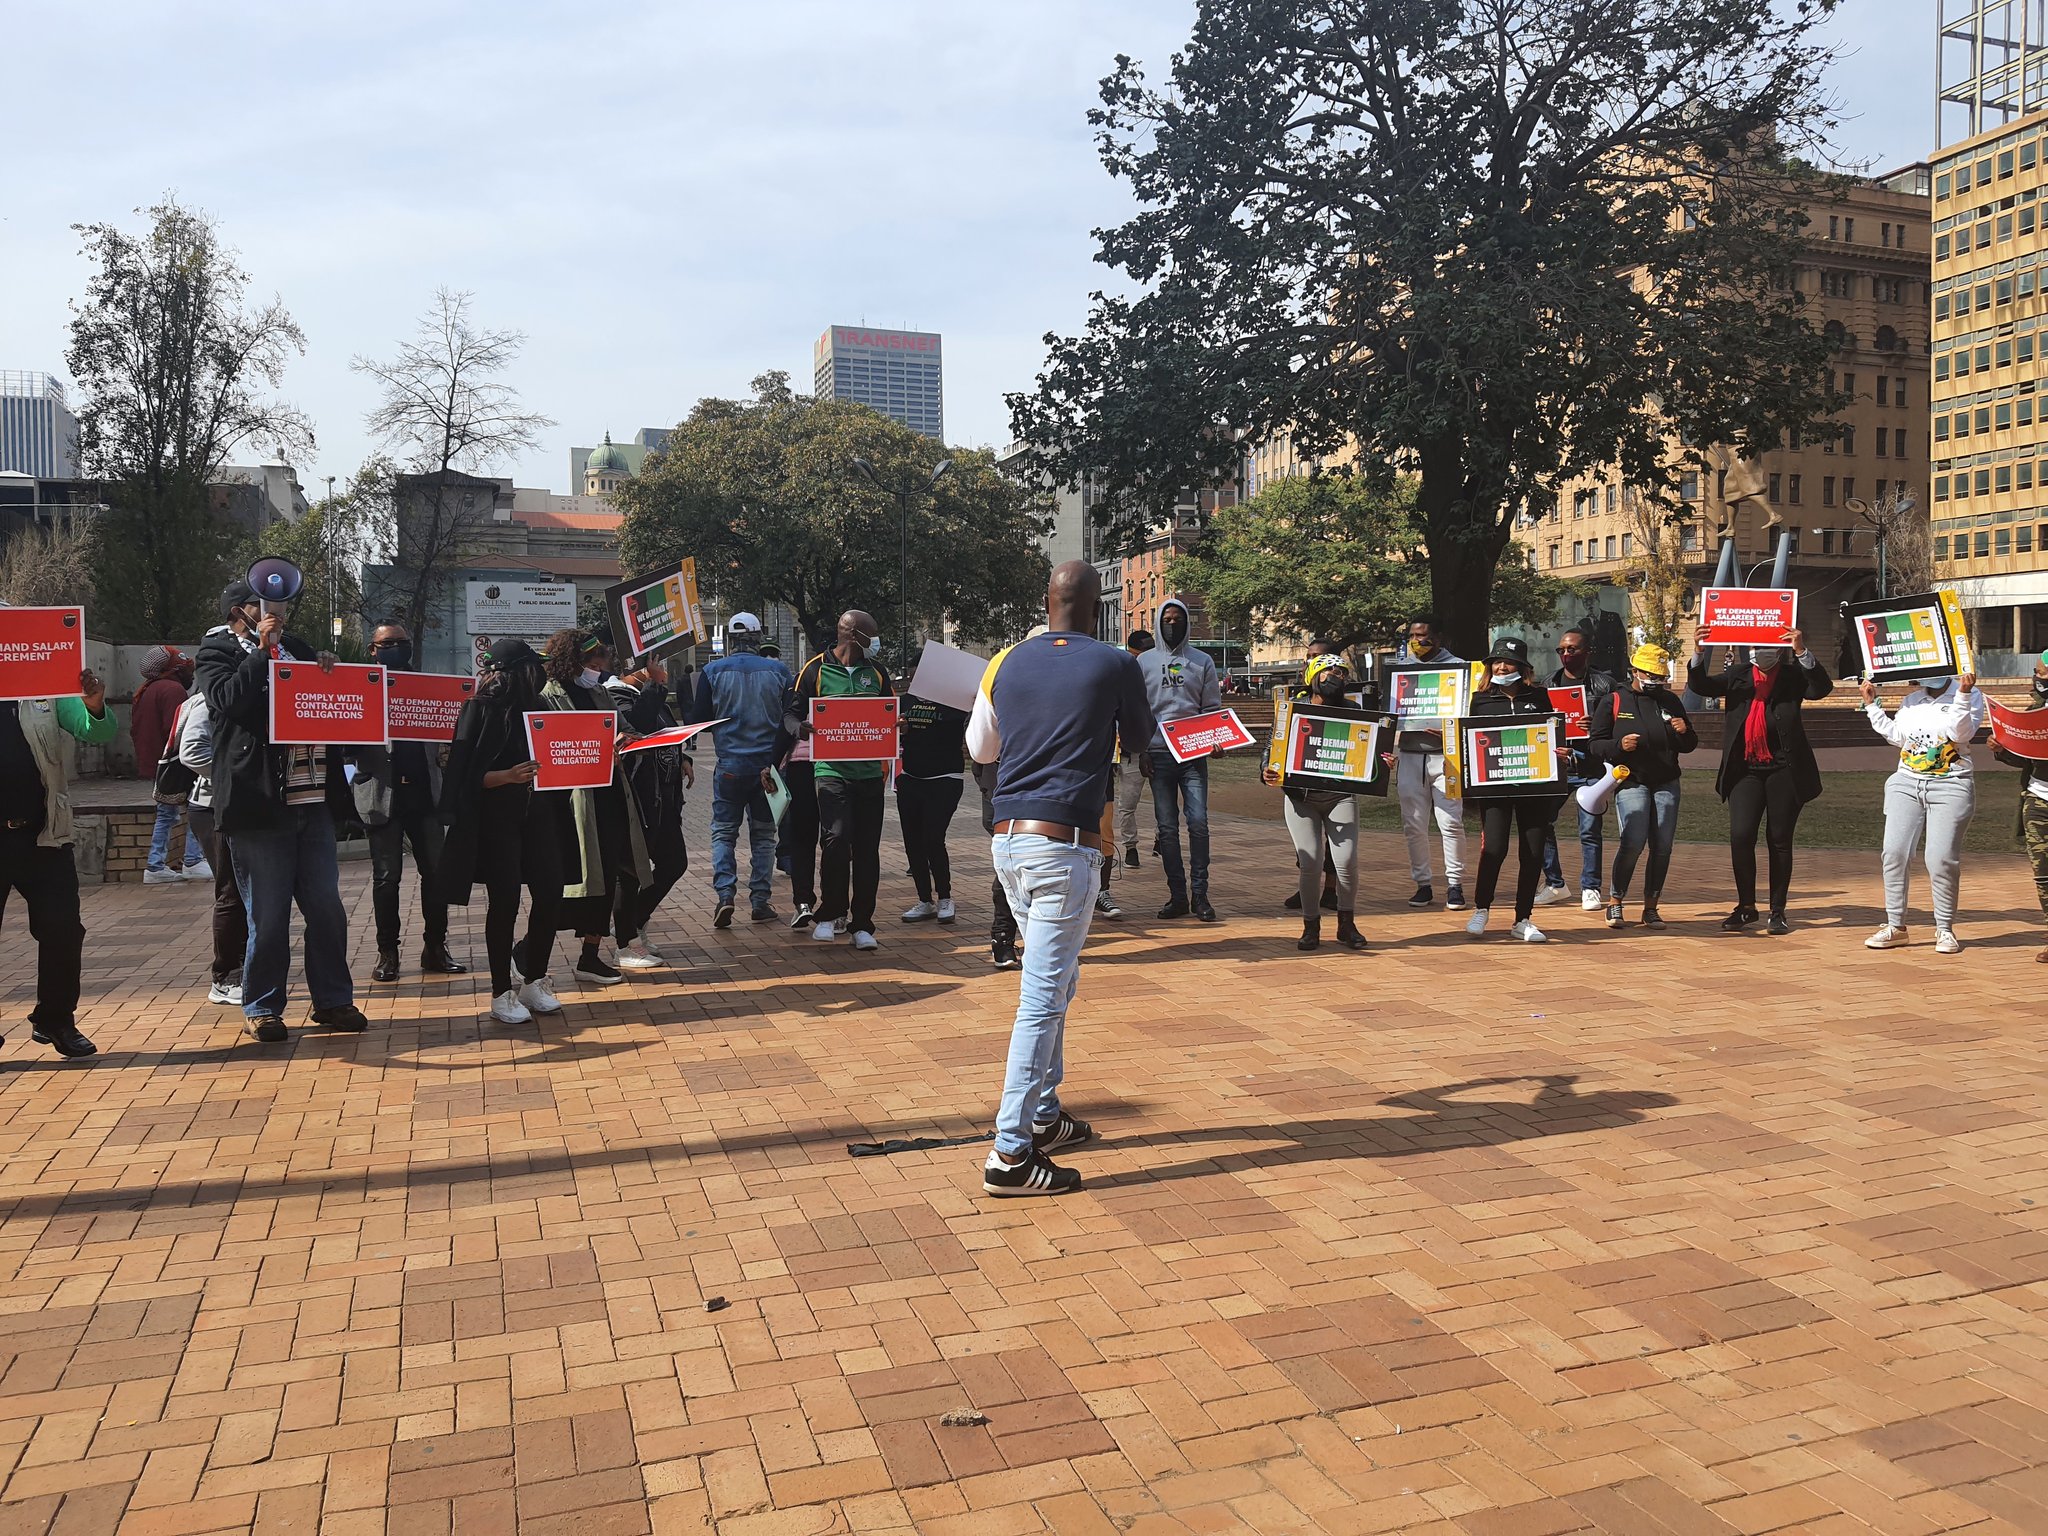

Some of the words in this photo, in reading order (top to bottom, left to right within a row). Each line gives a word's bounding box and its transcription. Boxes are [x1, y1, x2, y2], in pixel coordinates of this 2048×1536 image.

[836, 329, 936, 352] TRANSNET
[636, 614, 646, 622] WE
[646, 604, 666, 619] DEMAND
[642, 617, 661, 631] SALARY
[1886, 632, 1900, 641] PAY
[1901, 630, 1913, 640] UIF
[33, 642, 74, 651] SALARY
[1872, 640, 1933, 654] CONTRIBUTIONS
[1873, 657, 1884, 666] OR
[1884, 655, 1902, 665] FACE
[1903, 653, 1918, 663] JAIL
[1919, 651, 1938, 662] TIME
[1161, 675, 1184, 686] ANC
[295, 693, 334, 702] COMPLY
[406, 698, 442, 706] DEMAND
[295, 702, 364, 711] CONTRACTUAL
[388, 705, 438, 713] PROVIDENT
[296, 710, 363, 719] OBLIGATIONS
[1188, 729, 1214, 739] DEMAND
[2002, 722, 2033, 735] DEMAND
[1179, 734, 1214, 745] PROVIDENT
[1183, 733, 1234, 748] CONTRIBUTIONS
[1309, 736, 1322, 746] WE
[1322, 738, 1355, 749] DEMAND
[550, 748, 600, 757] CONTRACTUAL
[1316, 749, 1346, 760] SALARY
[1488, 747, 1502, 756] WE
[1502, 744, 1536, 754] DEMAND
[552, 756, 599, 764] OBLIGATIONS
[1498, 756, 1528, 767] SALARY
[1304, 760, 1354, 772] INCREAMENT
[1489, 766, 1538, 778] INCREAMENT
